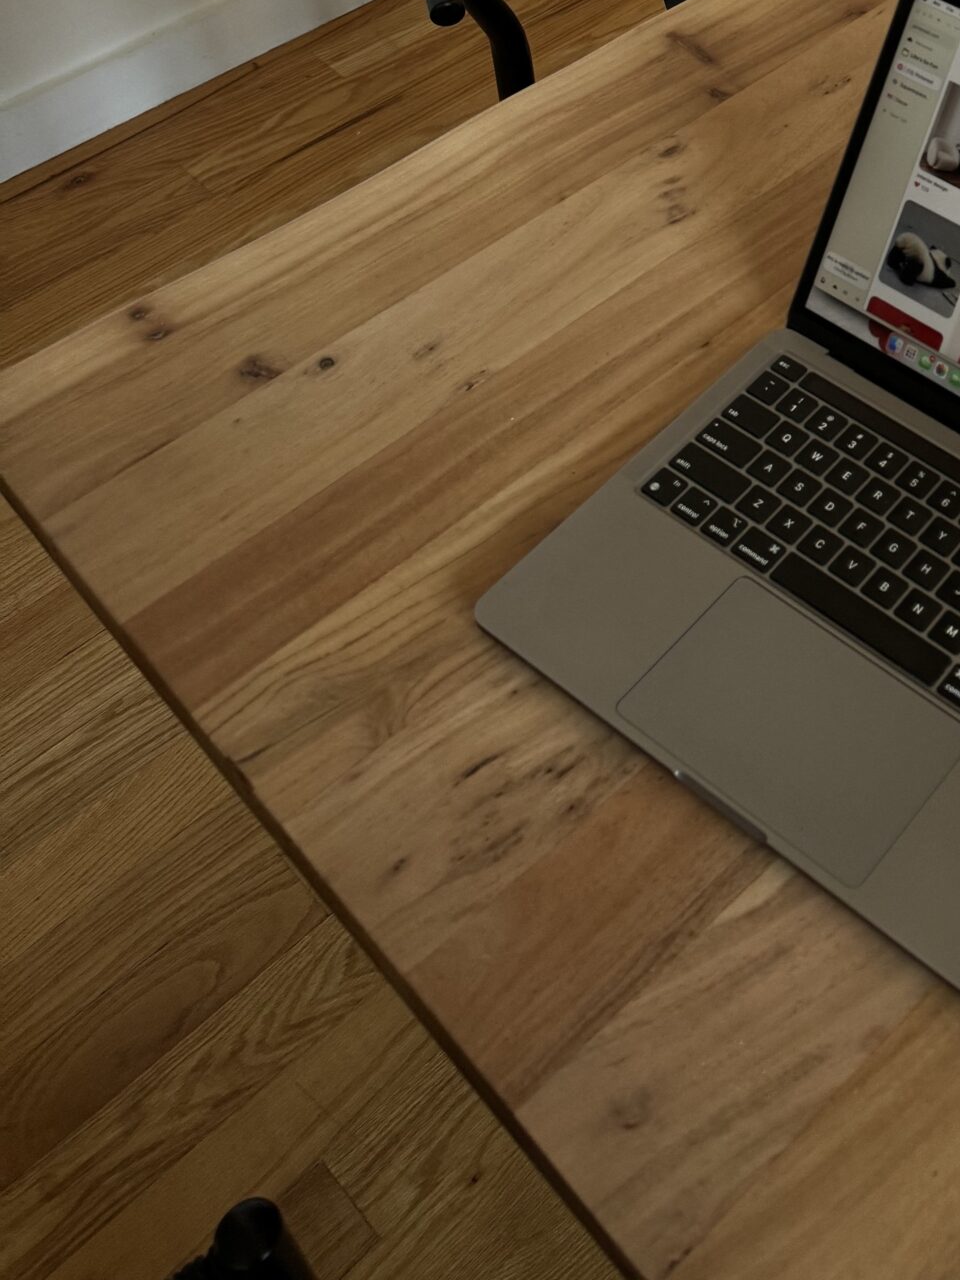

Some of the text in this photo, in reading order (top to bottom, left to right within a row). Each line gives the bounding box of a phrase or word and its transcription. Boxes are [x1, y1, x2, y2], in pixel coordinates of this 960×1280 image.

[729, 409, 739, 417] tab
[818, 422, 828, 431] 2
[782, 434, 792, 443] Q
[848, 441, 858, 449] 3
[812, 452, 824, 462] W
[764, 464, 773, 473] A
[842, 472, 853, 481] E
[795, 483, 805, 492] S
[910, 479, 920, 488] 5
[873, 491, 883, 500] R
[754, 499, 765, 509] Z
[825, 502, 835, 512] D
[941, 499, 951, 508] 6
[678, 504, 700, 519] control
[906, 511, 916, 520] T
[784, 519, 795, 529] X
[857, 522, 867, 530] F
[708, 525, 729, 541] option
[939, 531, 948, 540] Y
[815, 540, 826, 549] C
[889, 543, 899, 553] G
[738, 545, 769, 568] command
[849, 560, 859, 570] V
[921, 564, 932, 575] H
[880, 582, 890, 592] B
[913, 604, 925, 615] N
[947, 626, 959, 638] M
